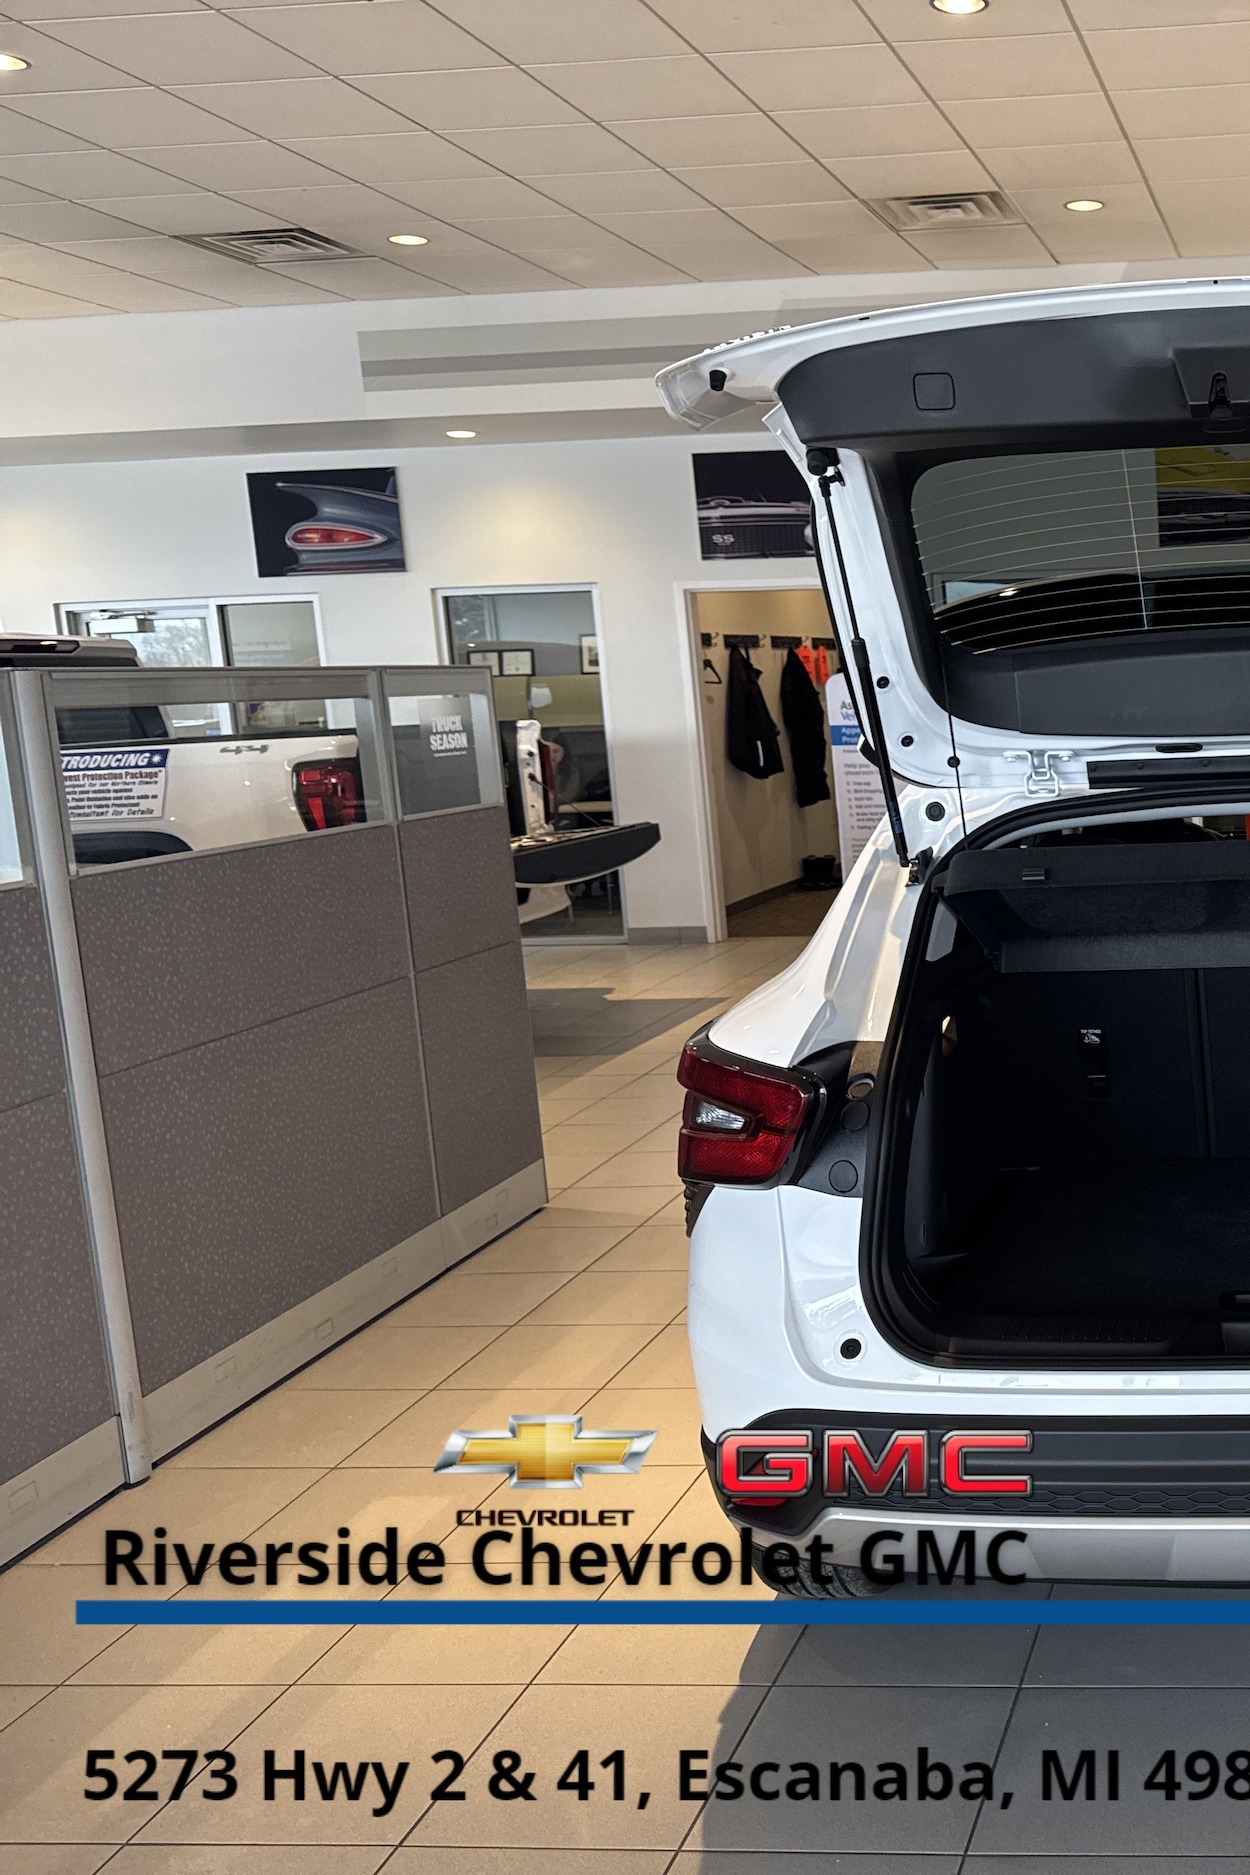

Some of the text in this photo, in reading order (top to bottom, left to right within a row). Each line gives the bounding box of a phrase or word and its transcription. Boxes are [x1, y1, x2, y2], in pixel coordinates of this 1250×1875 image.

[431, 714, 463, 733] TRUCK
[429, 732, 469, 751] SEASON
[81, 771, 123, 782] Protection
